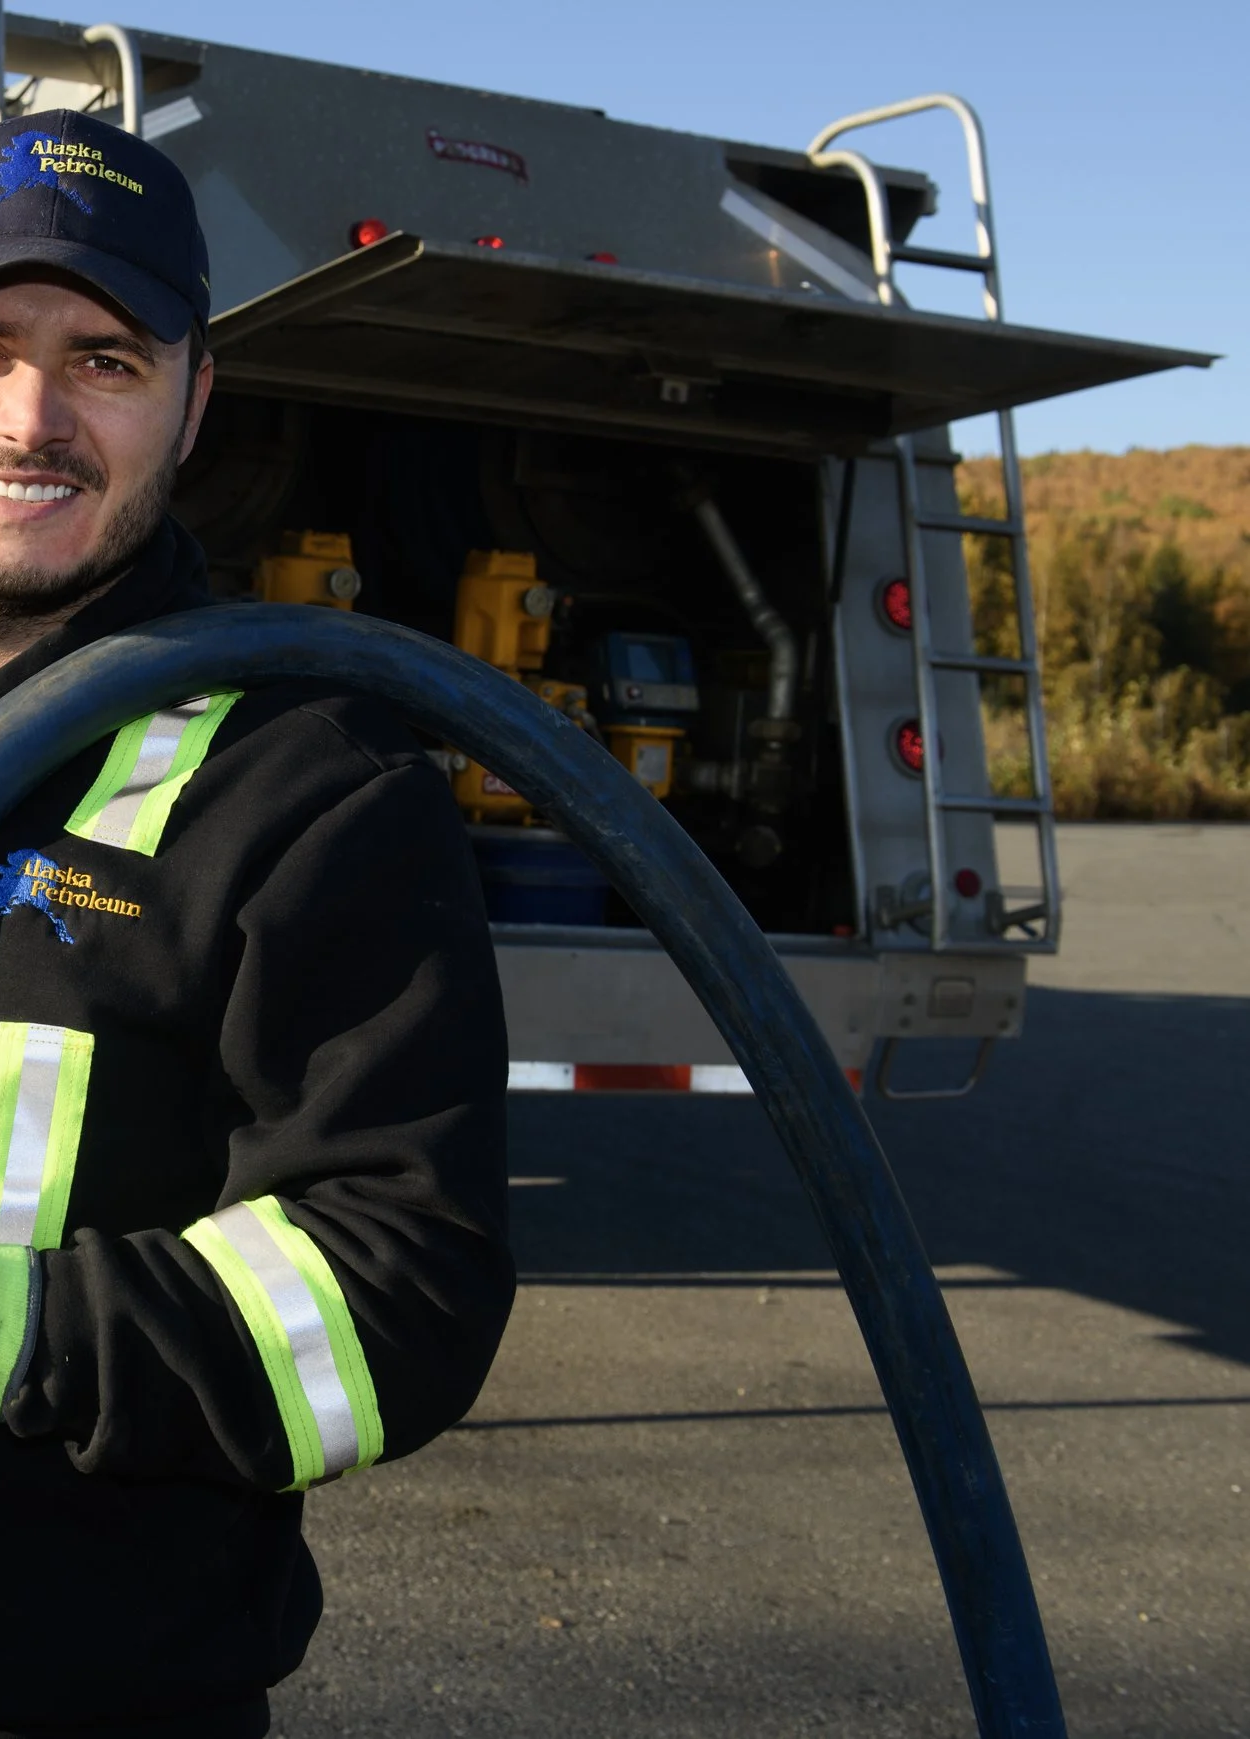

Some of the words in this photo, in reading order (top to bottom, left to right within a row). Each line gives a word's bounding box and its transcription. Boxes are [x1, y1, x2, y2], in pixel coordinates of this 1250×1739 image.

[30, 140, 103, 160] Alaska
[39, 157, 144, 195] Petroleum
[16, 859, 92, 889] Alaska
[30, 880, 143, 918] Petroleum
